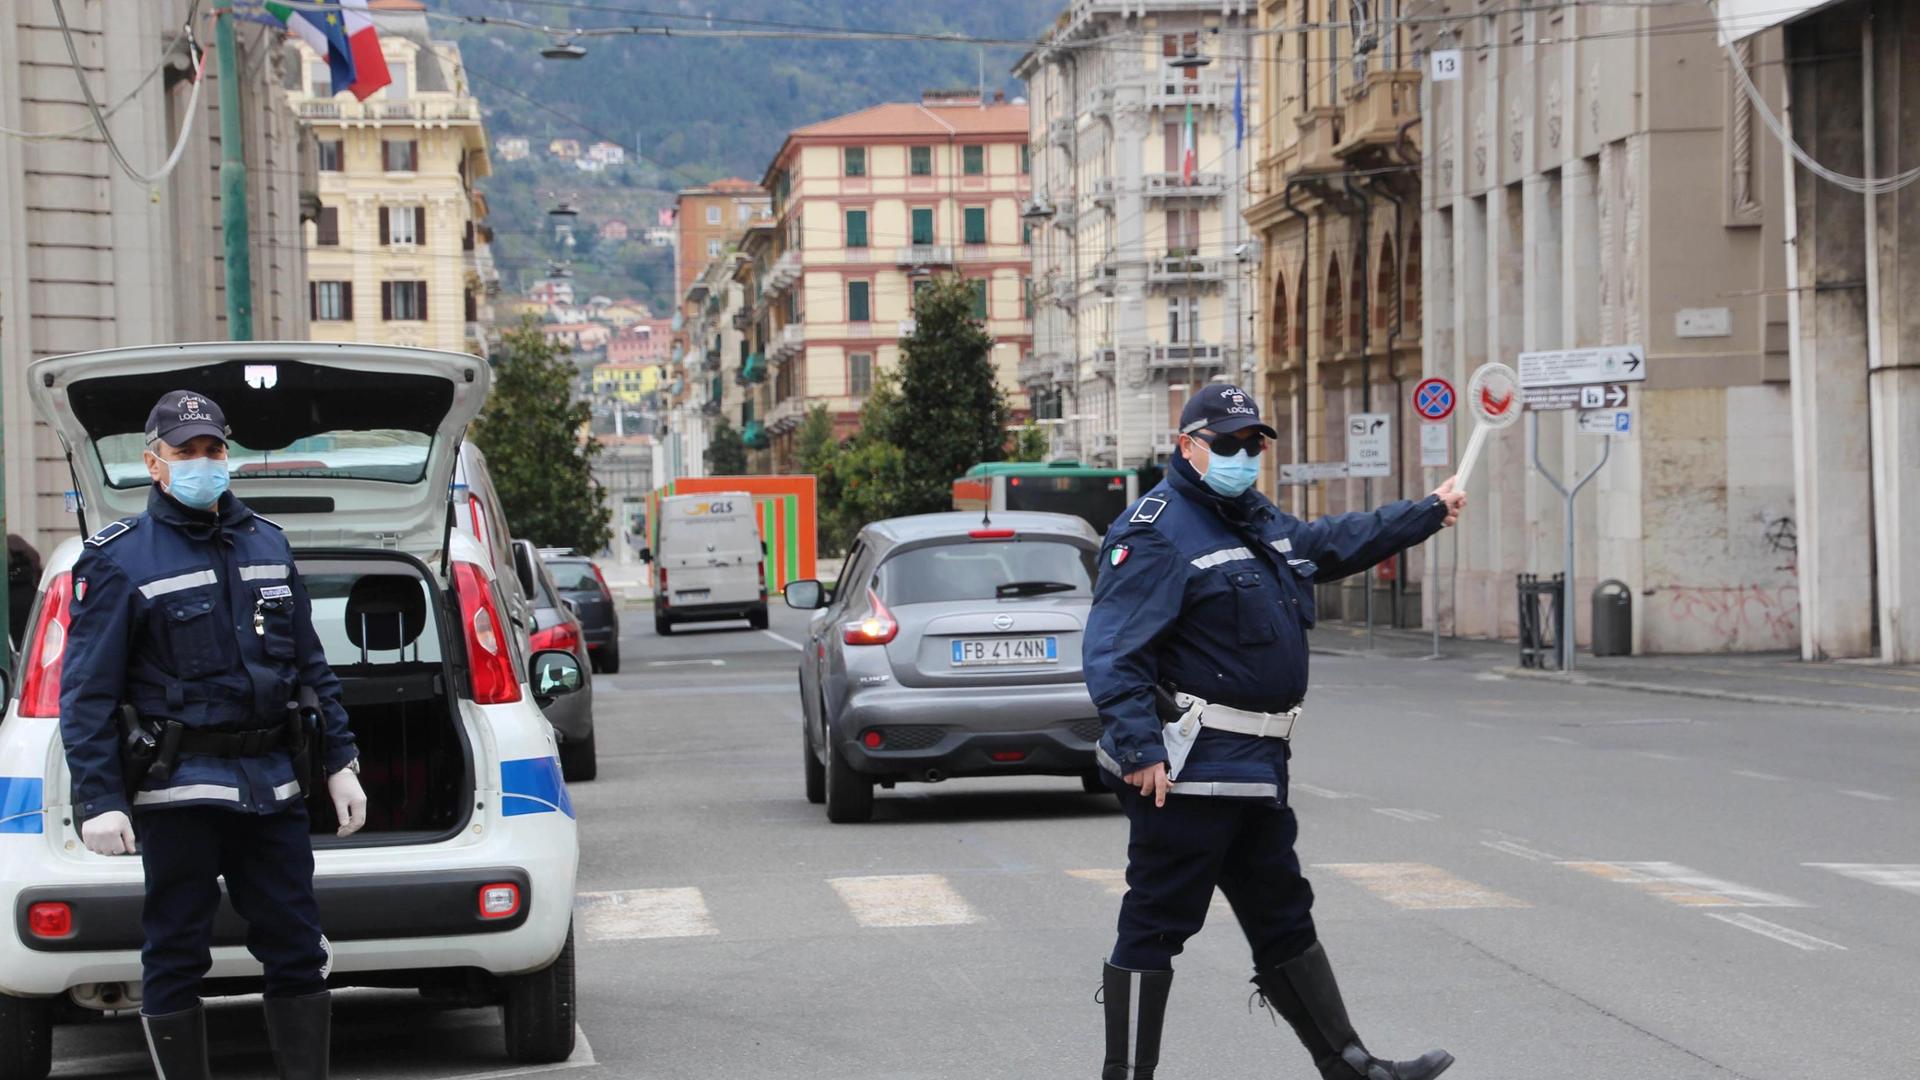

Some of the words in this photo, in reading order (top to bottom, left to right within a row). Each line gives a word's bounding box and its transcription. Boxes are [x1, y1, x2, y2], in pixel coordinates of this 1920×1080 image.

[1438, 58, 1455, 73] 13
[1220, 388, 1247, 399] POLI
[1226, 407, 1255, 415] LOCALE
[178, 413, 212, 421] LOCALE
[710, 501, 733, 513] GLS
[963, 642, 985, 659] FB
[992, 640, 1045, 658] 414NN
